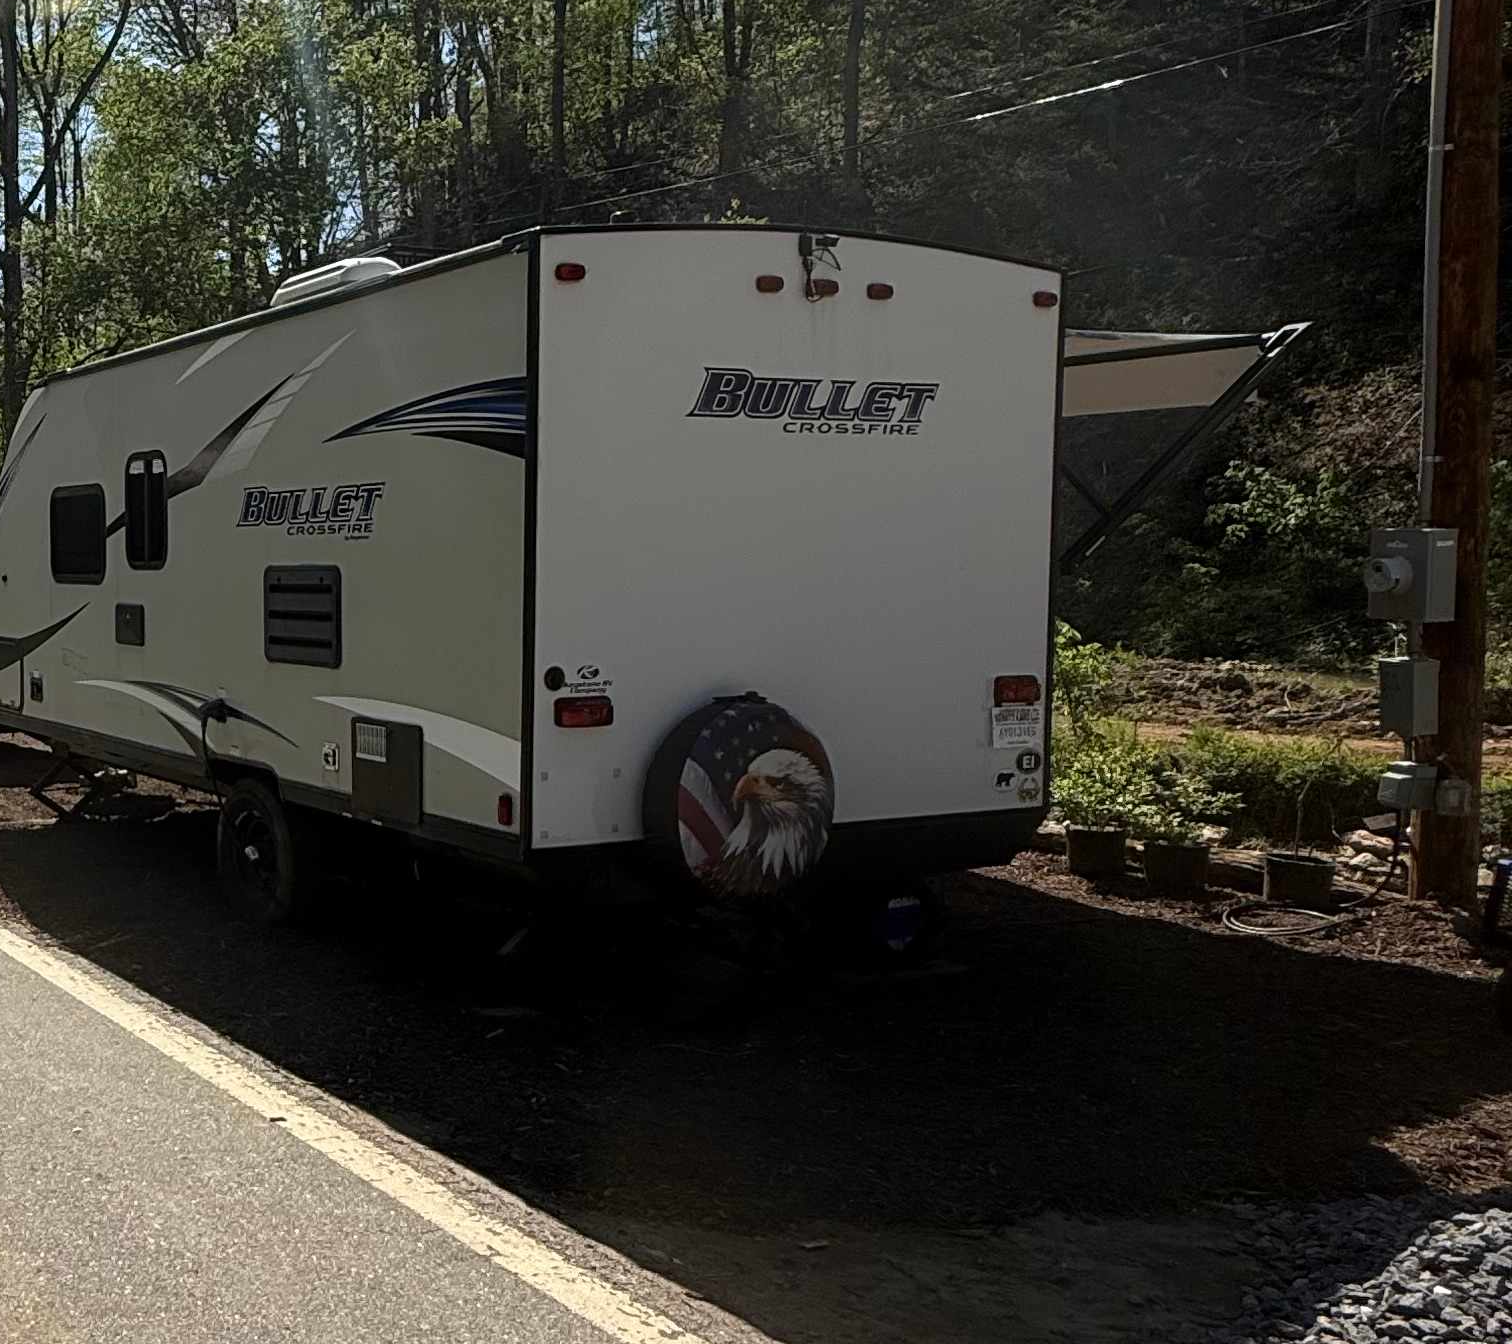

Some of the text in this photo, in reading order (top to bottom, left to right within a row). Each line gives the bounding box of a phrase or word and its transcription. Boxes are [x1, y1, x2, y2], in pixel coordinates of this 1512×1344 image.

[685, 367, 940, 423] BULLET
[782, 422, 920, 436] CROSSFIRE
[236, 481, 386, 527] BULLET
[286, 523, 373, 536] CROSSFIRE
